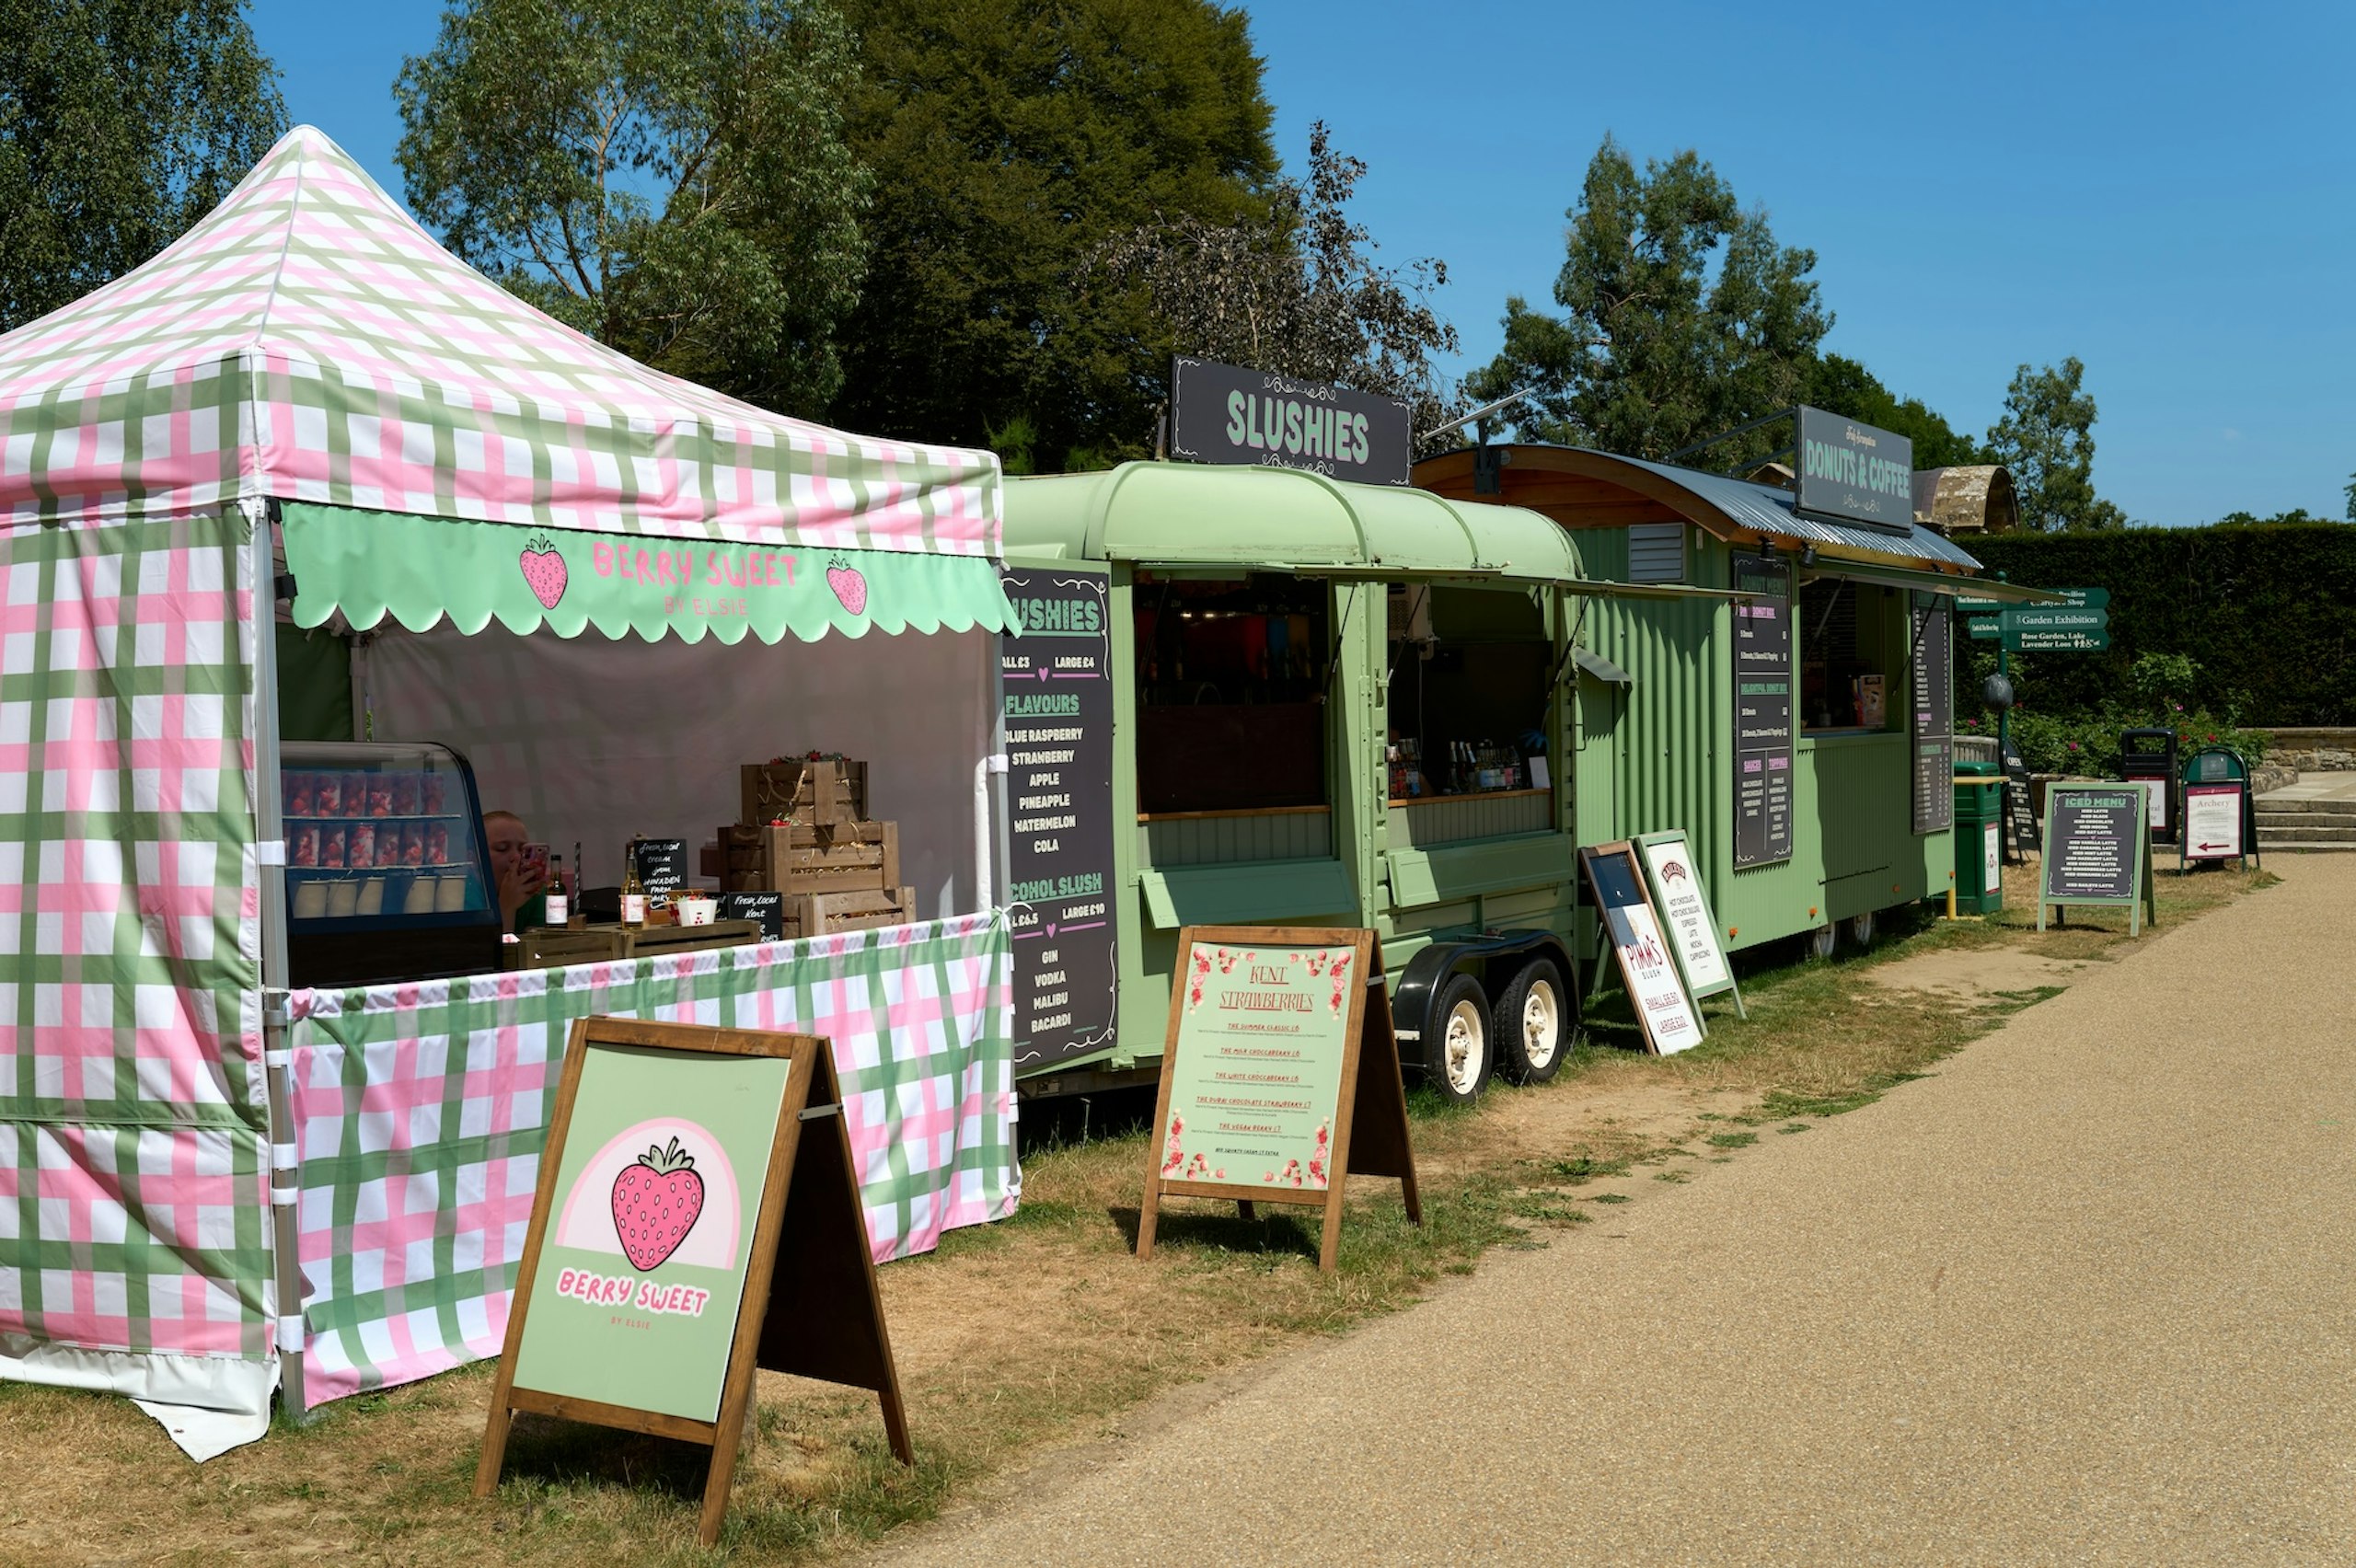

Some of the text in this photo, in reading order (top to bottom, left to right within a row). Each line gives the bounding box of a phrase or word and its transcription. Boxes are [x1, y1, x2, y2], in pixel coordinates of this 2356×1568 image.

[1226, 389, 1369, 465] SLUSHIES
[1806, 439, 1911, 500] DONUTS & COFFEE
[594, 542, 798, 590] BERRY SWEET
[664, 596, 750, 617] BY ELSIE
[1012, 597, 1101, 631] USHIES
[2021, 615, 2098, 625] Garden Exhibition
[1002, 656, 1031, 669] ALL £3
[1055, 656, 1095, 669] LARGE £4
[1005, 694, 1080, 714] FLAVOURS
[1004, 727, 1084, 744] BLUE RASPBERRY
[1011, 749, 1075, 767] STRAWBERRY
[2006, 756, 2023, 767] OPEN
[1029, 772, 1059, 788] APPLE
[1019, 793, 1070, 811] PINEAPPLE
[2065, 798, 2127, 806] ICED MENU
[2197, 799, 2231, 809] Archery
[1013, 814, 1077, 833] WATERMELON
[1034, 838, 1059, 854] COLA
[1011, 872, 1103, 903] COHOL SLUSH
[744, 907, 767, 919] Kent
[1062, 902, 1105, 920] LARGE £10
[1018, 913, 1039, 928] £6.5
[1041, 949, 1059, 964] GIN
[1625, 934, 1663, 972] PIMM'S
[1034, 969, 1067, 987] VODKA
[1250, 965, 1289, 984] KENT
[1641, 968, 1662, 980] SLUSH
[1034, 990, 1069, 1010] MALIBU
[1219, 990, 1315, 1012] STRAWBERRIES
[1031, 1011, 1071, 1033] BACARDI
[1228, 1022, 1239, 1031] THE
[1228, 1072, 1246, 1080] WHITE
[1228, 1098, 1262, 1106] CHOCOLATE
[1264, 1099, 1302, 1108] STRAWBERRY
[1252, 1124, 1271, 1133] BERRY
[557, 1269, 709, 1316] BERRY SWEET
[611, 1316, 652, 1331] BY ELSIE
